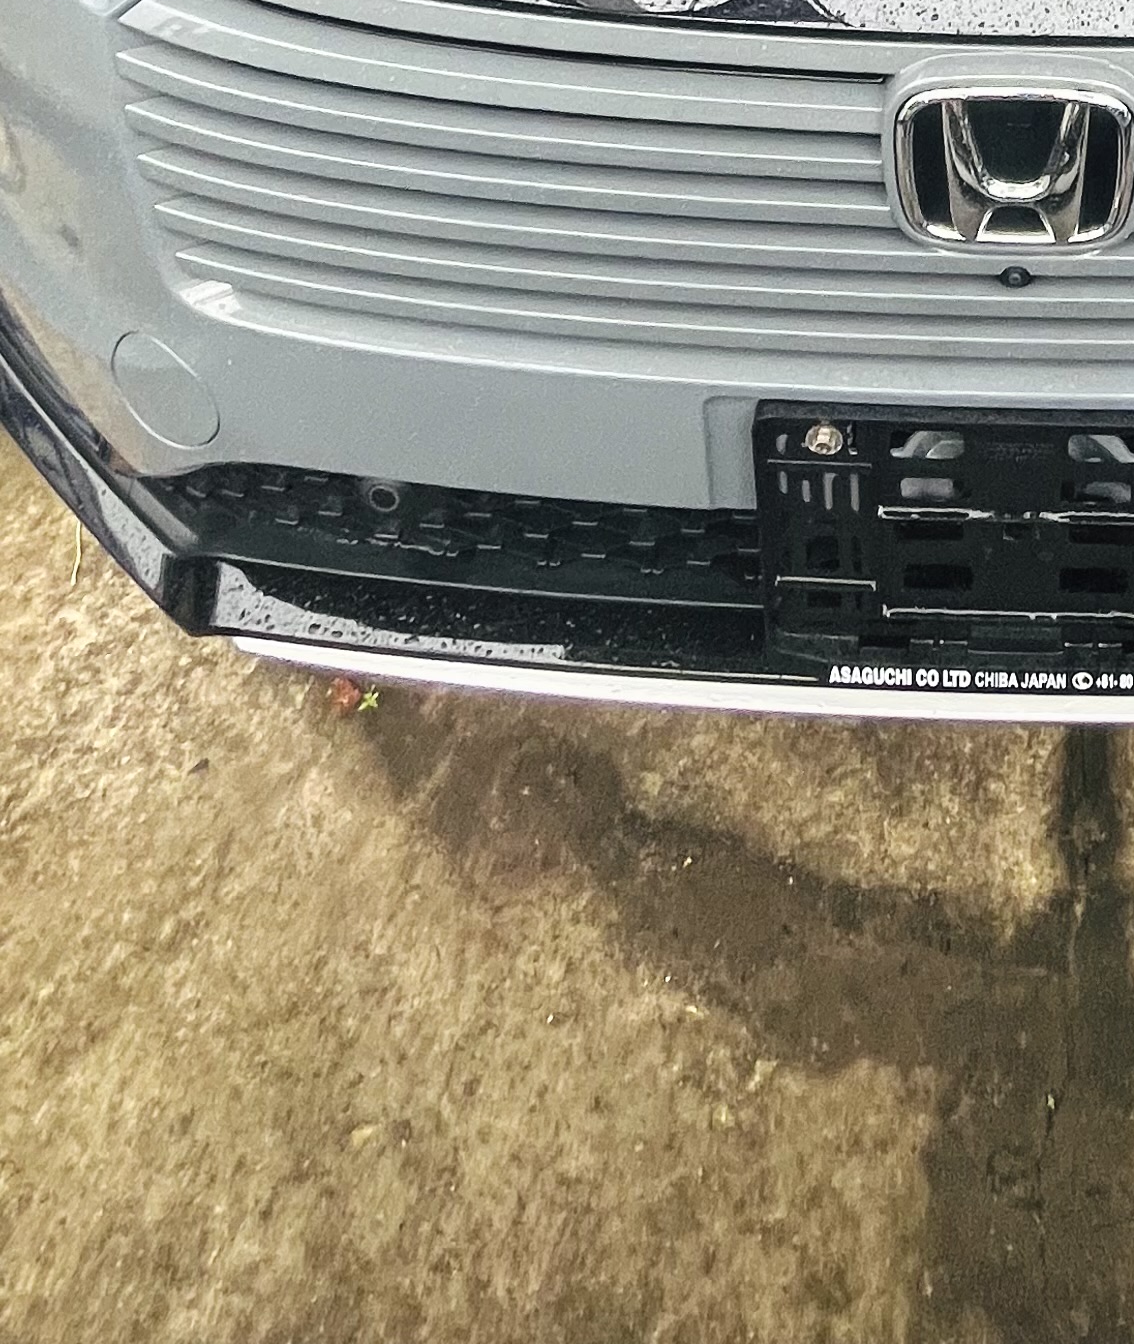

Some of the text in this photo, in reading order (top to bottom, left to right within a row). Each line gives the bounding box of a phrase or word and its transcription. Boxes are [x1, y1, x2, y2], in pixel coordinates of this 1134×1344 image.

[829, 665, 911, 686] ASAGUCHI
[915, 668, 940, 688] CO
[942, 669, 971, 689] LTD
[974, 670, 1019, 690] CHIBA
[1020, 672, 1067, 691] JAPAN
